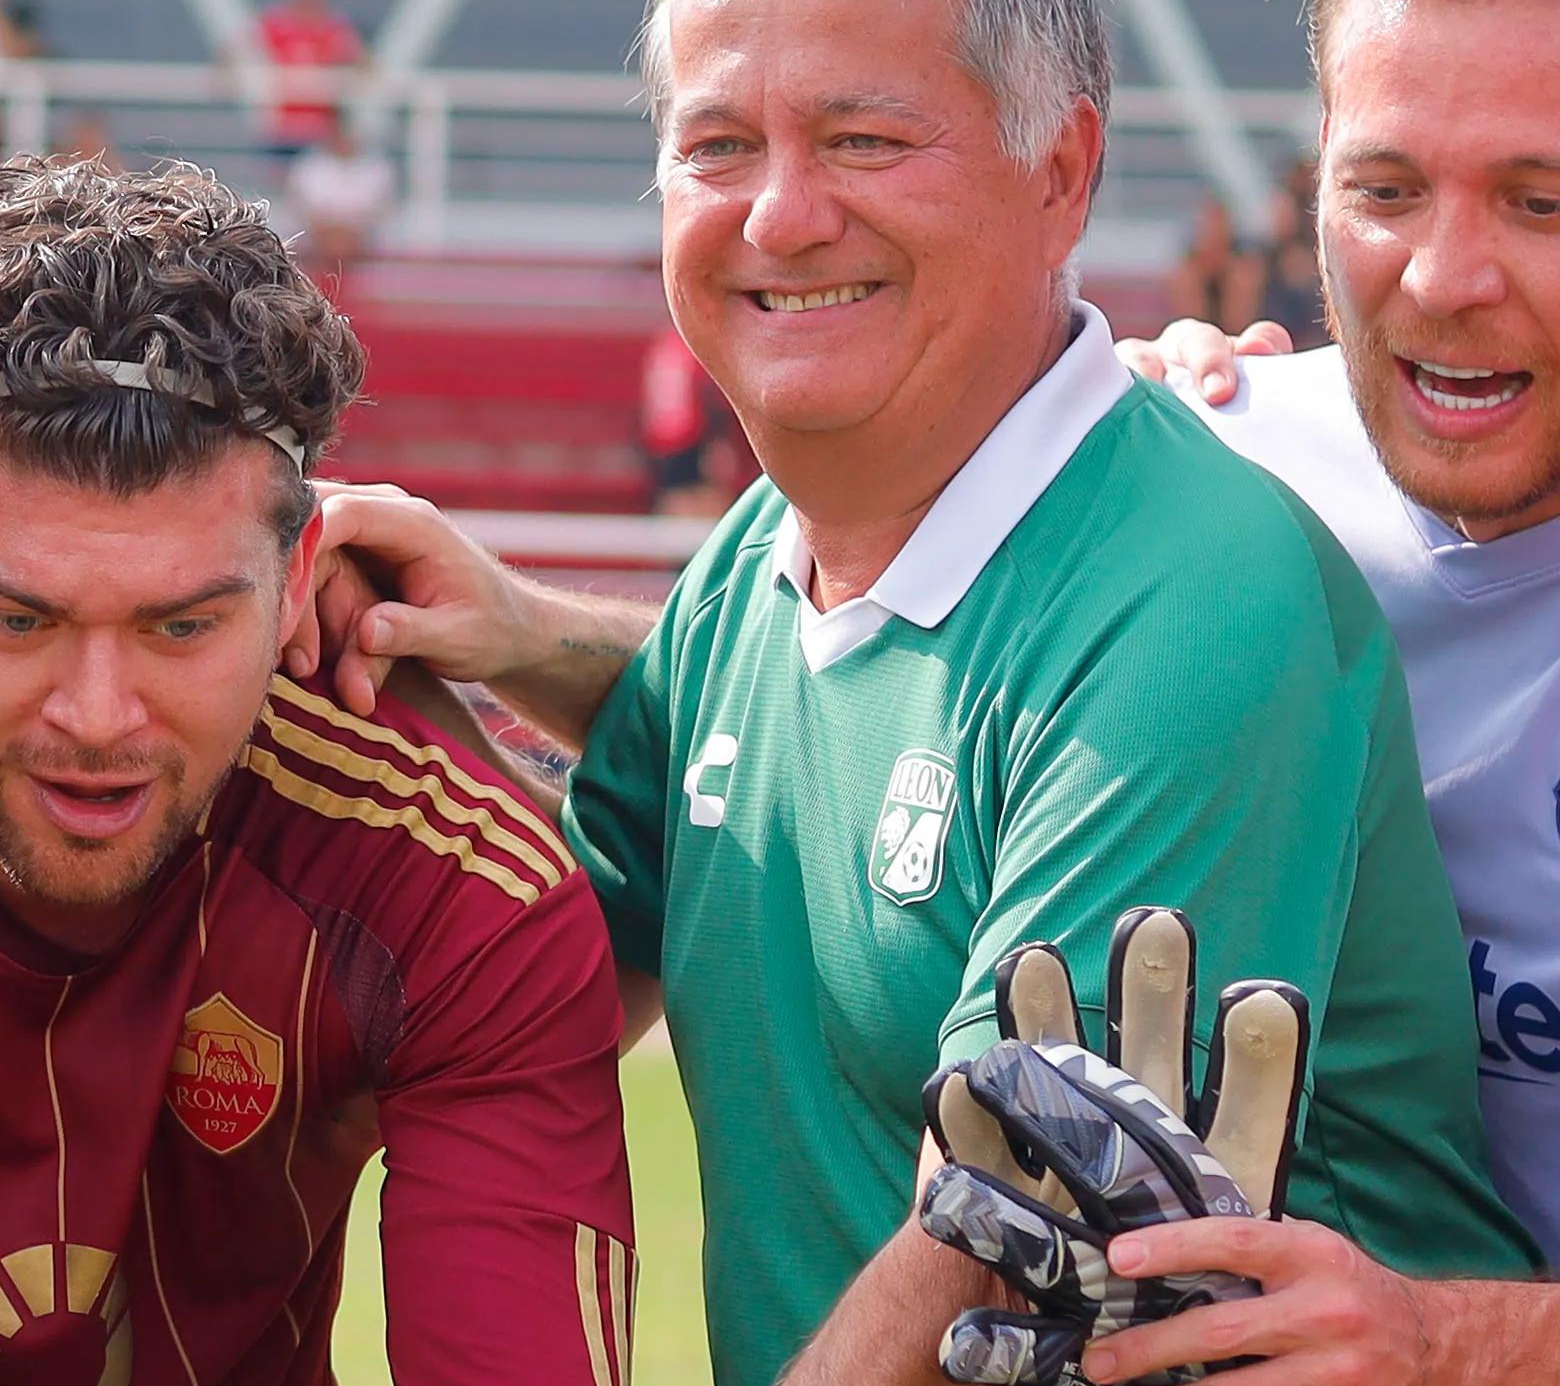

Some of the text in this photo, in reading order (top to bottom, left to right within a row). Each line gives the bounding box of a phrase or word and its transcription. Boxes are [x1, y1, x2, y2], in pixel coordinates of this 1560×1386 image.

[893, 763, 950, 806] LEON
[176, 1086, 265, 1116] ROMA
[204, 1118, 237, 1134] 1927
